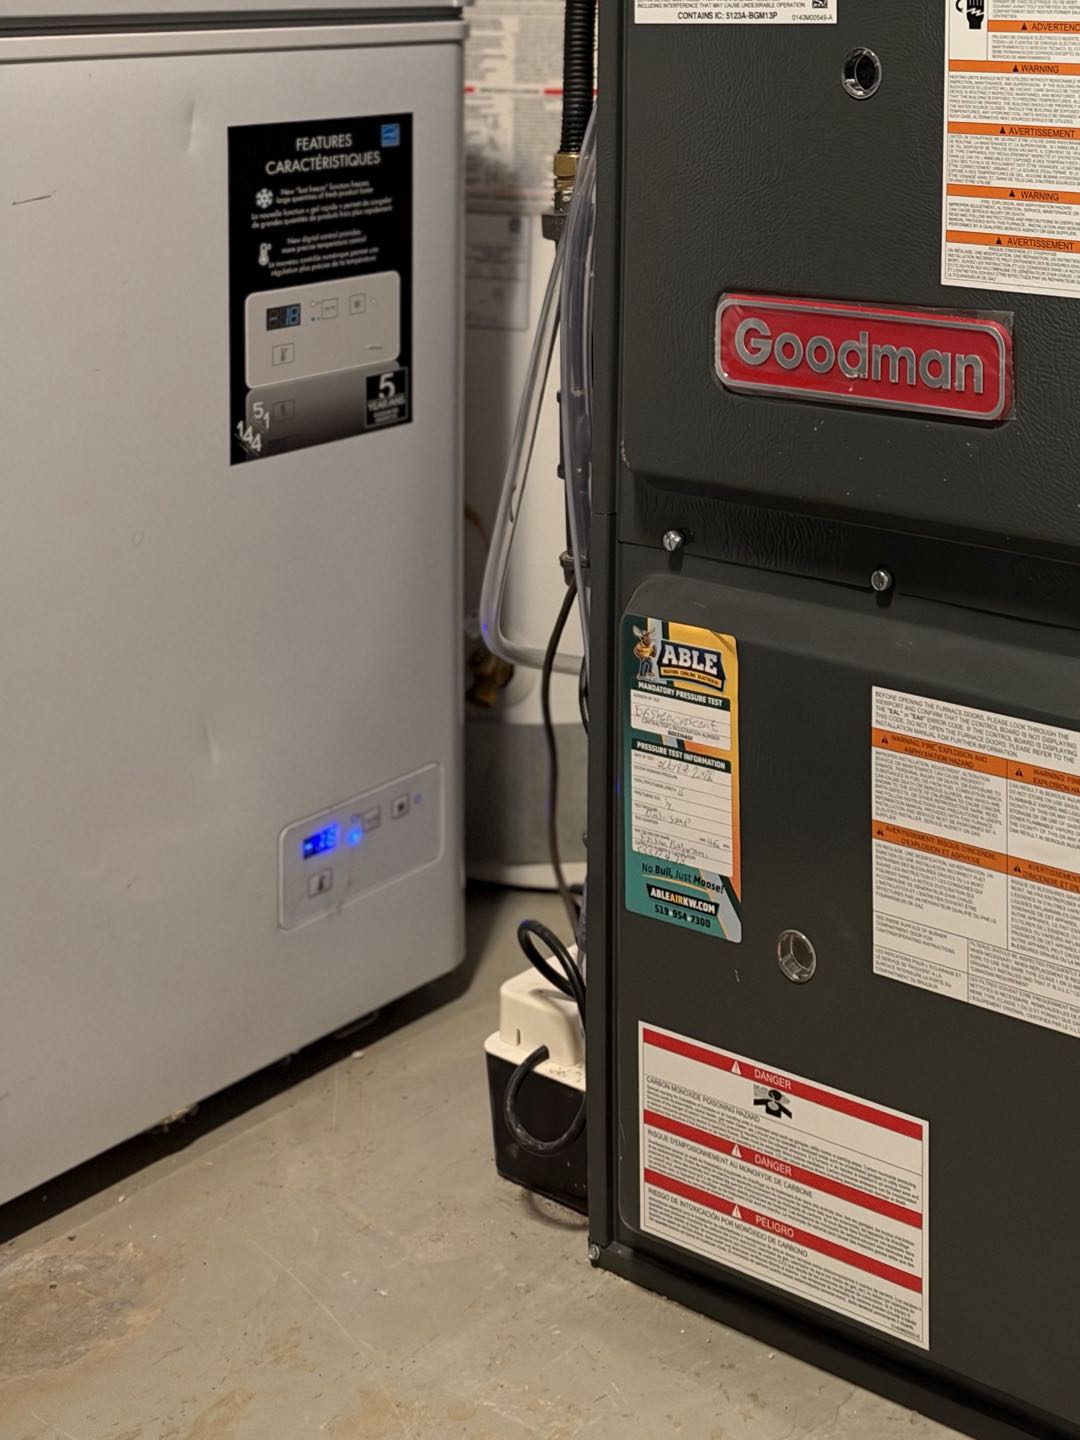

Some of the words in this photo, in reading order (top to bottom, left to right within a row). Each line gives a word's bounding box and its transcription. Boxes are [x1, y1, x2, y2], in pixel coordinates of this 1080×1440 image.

[677, 11, 713, 20] CONTAINS
[1020, 64, 1060, 74] WARNING
[296, 133, 353, 152] FEATURES
[1008, 127, 1077, 139] AVERTISSEMENT
[265, 150, 382, 176] CARACTÉRISTIQUES
[1020, 191, 1060, 202] WARNING
[1007, 237, 1075, 251] AVERTISSEMENT
[735, 317, 985, 395] Goodman
[379, 372, 396, 399] 5
[661, 644, 719, 676] ABLE
[638, 681, 675, 696] MANDATORY
[675, 689, 707, 704] PRESSURE
[707, 696, 723, 707] TEST
[636, 740, 667, 755] PRESSURE
[667, 748, 683, 759] TEST
[683, 752, 726, 770] INFORMATION
[641, 863, 654, 874] No
[655, 864, 674, 879] Bull,
[674, 868, 692, 883] Just
[693, 876, 725, 894] Moose!
[650, 887, 716, 915] ABLEAIRKW.COM
[753, 1068, 792, 1091] DANGER
[646, 1075, 671, 1090] CARBON
[671, 1083, 702, 1103] MONOXIDE
[702, 1094, 736, 1114] POISONING
[736, 1106, 761, 1123] HAZARD
[647, 1128, 670, 1143] RISQUE
[669, 1135, 730, 1166] D'EMPOISONNEMENT
[730, 1157, 739, 1168] AU
[739, 1161, 773, 1183] MONOXYDE
[773, 1174, 783, 1186] DE
[783, 1178, 813, 1198] CARBONE
[754, 1153, 792, 1176] DANGER
[648, 1187, 671, 1202] RIESGO
[670, 1193, 680, 1205] DE
[720, 1212, 735, 1226] POR
[767, 1231, 777, 1244] DE
[777, 1235, 808, 1258] CARBONO
[754, 1215, 795, 1239] PELIGRO
